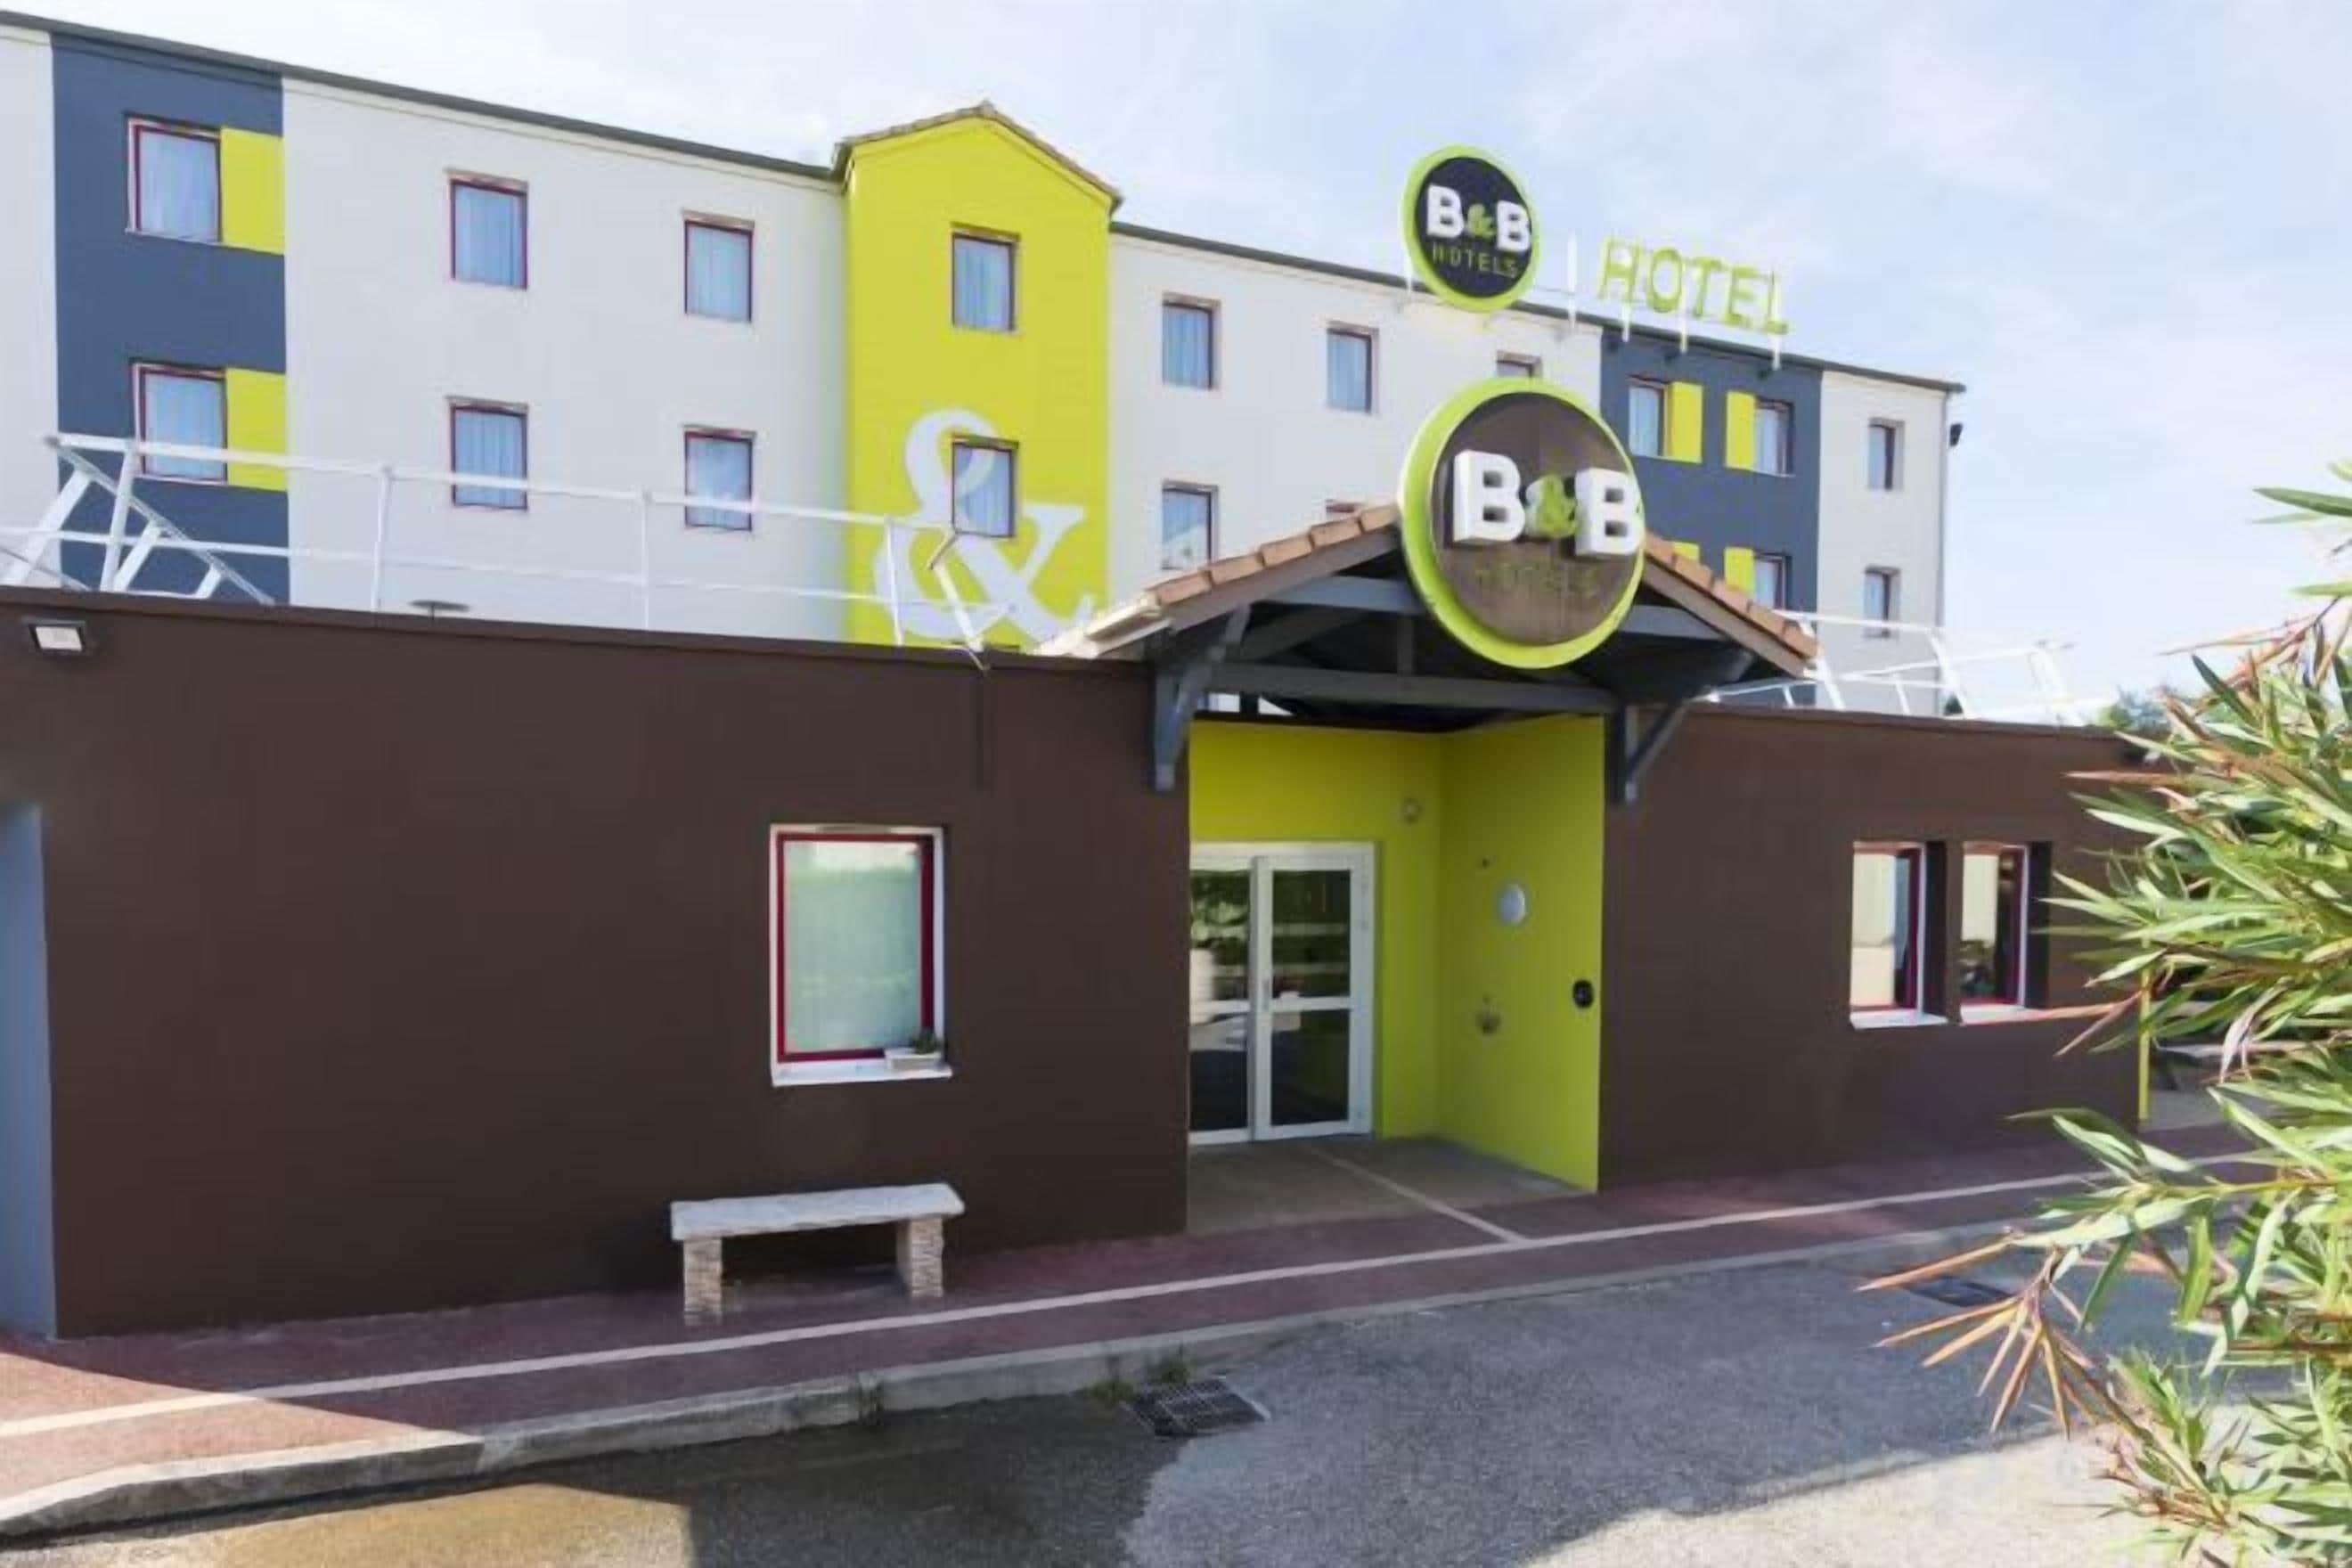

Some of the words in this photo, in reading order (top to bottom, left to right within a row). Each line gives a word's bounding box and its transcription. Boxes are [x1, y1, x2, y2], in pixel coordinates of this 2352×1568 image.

[1425, 184, 1532, 252] B&B
[1433, 244, 1515, 278] HOTELS
[1598, 236, 1790, 333] HOTEL
[1453, 449, 1645, 556] B&B
